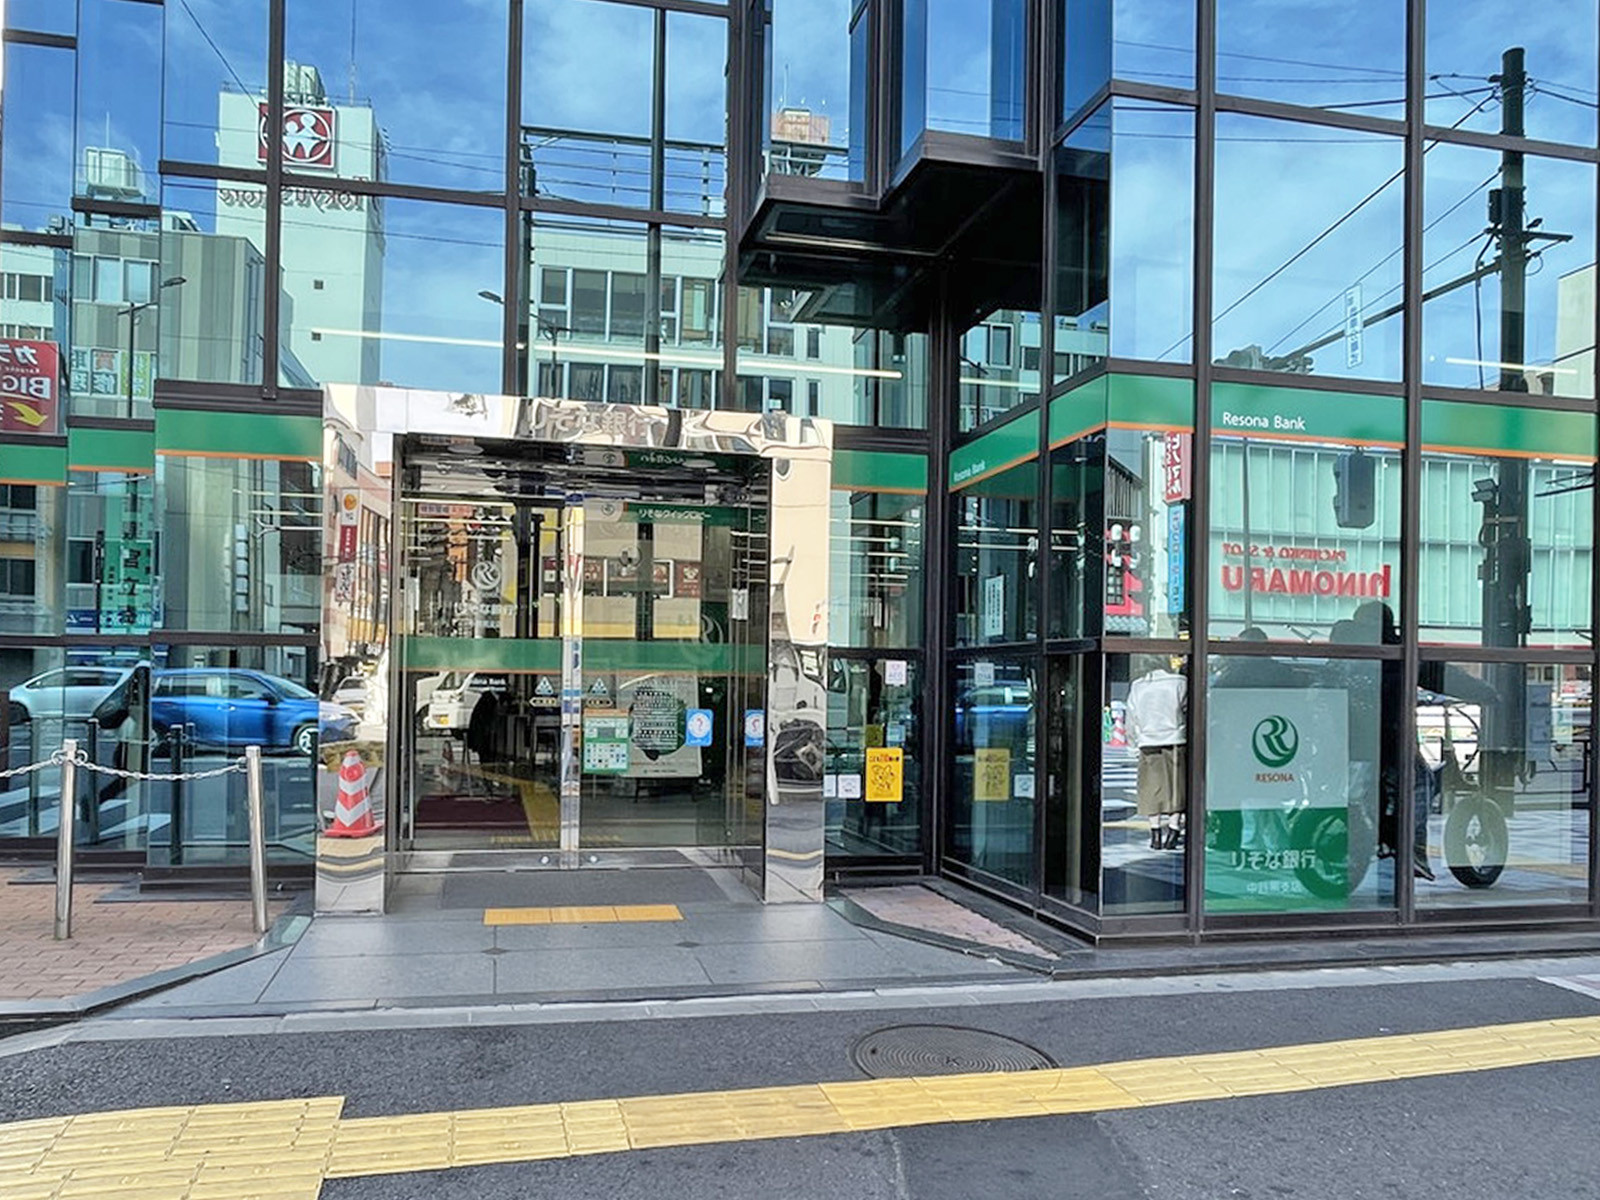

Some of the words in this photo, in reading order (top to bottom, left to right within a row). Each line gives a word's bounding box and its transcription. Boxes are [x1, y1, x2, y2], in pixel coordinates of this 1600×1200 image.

[1222, 411, 1269, 429] Resona
[1273, 415, 1306, 431] Bank
[1255, 773, 1294, 782] RESONA
[1231, 849, 1316, 871] りそな銀行
